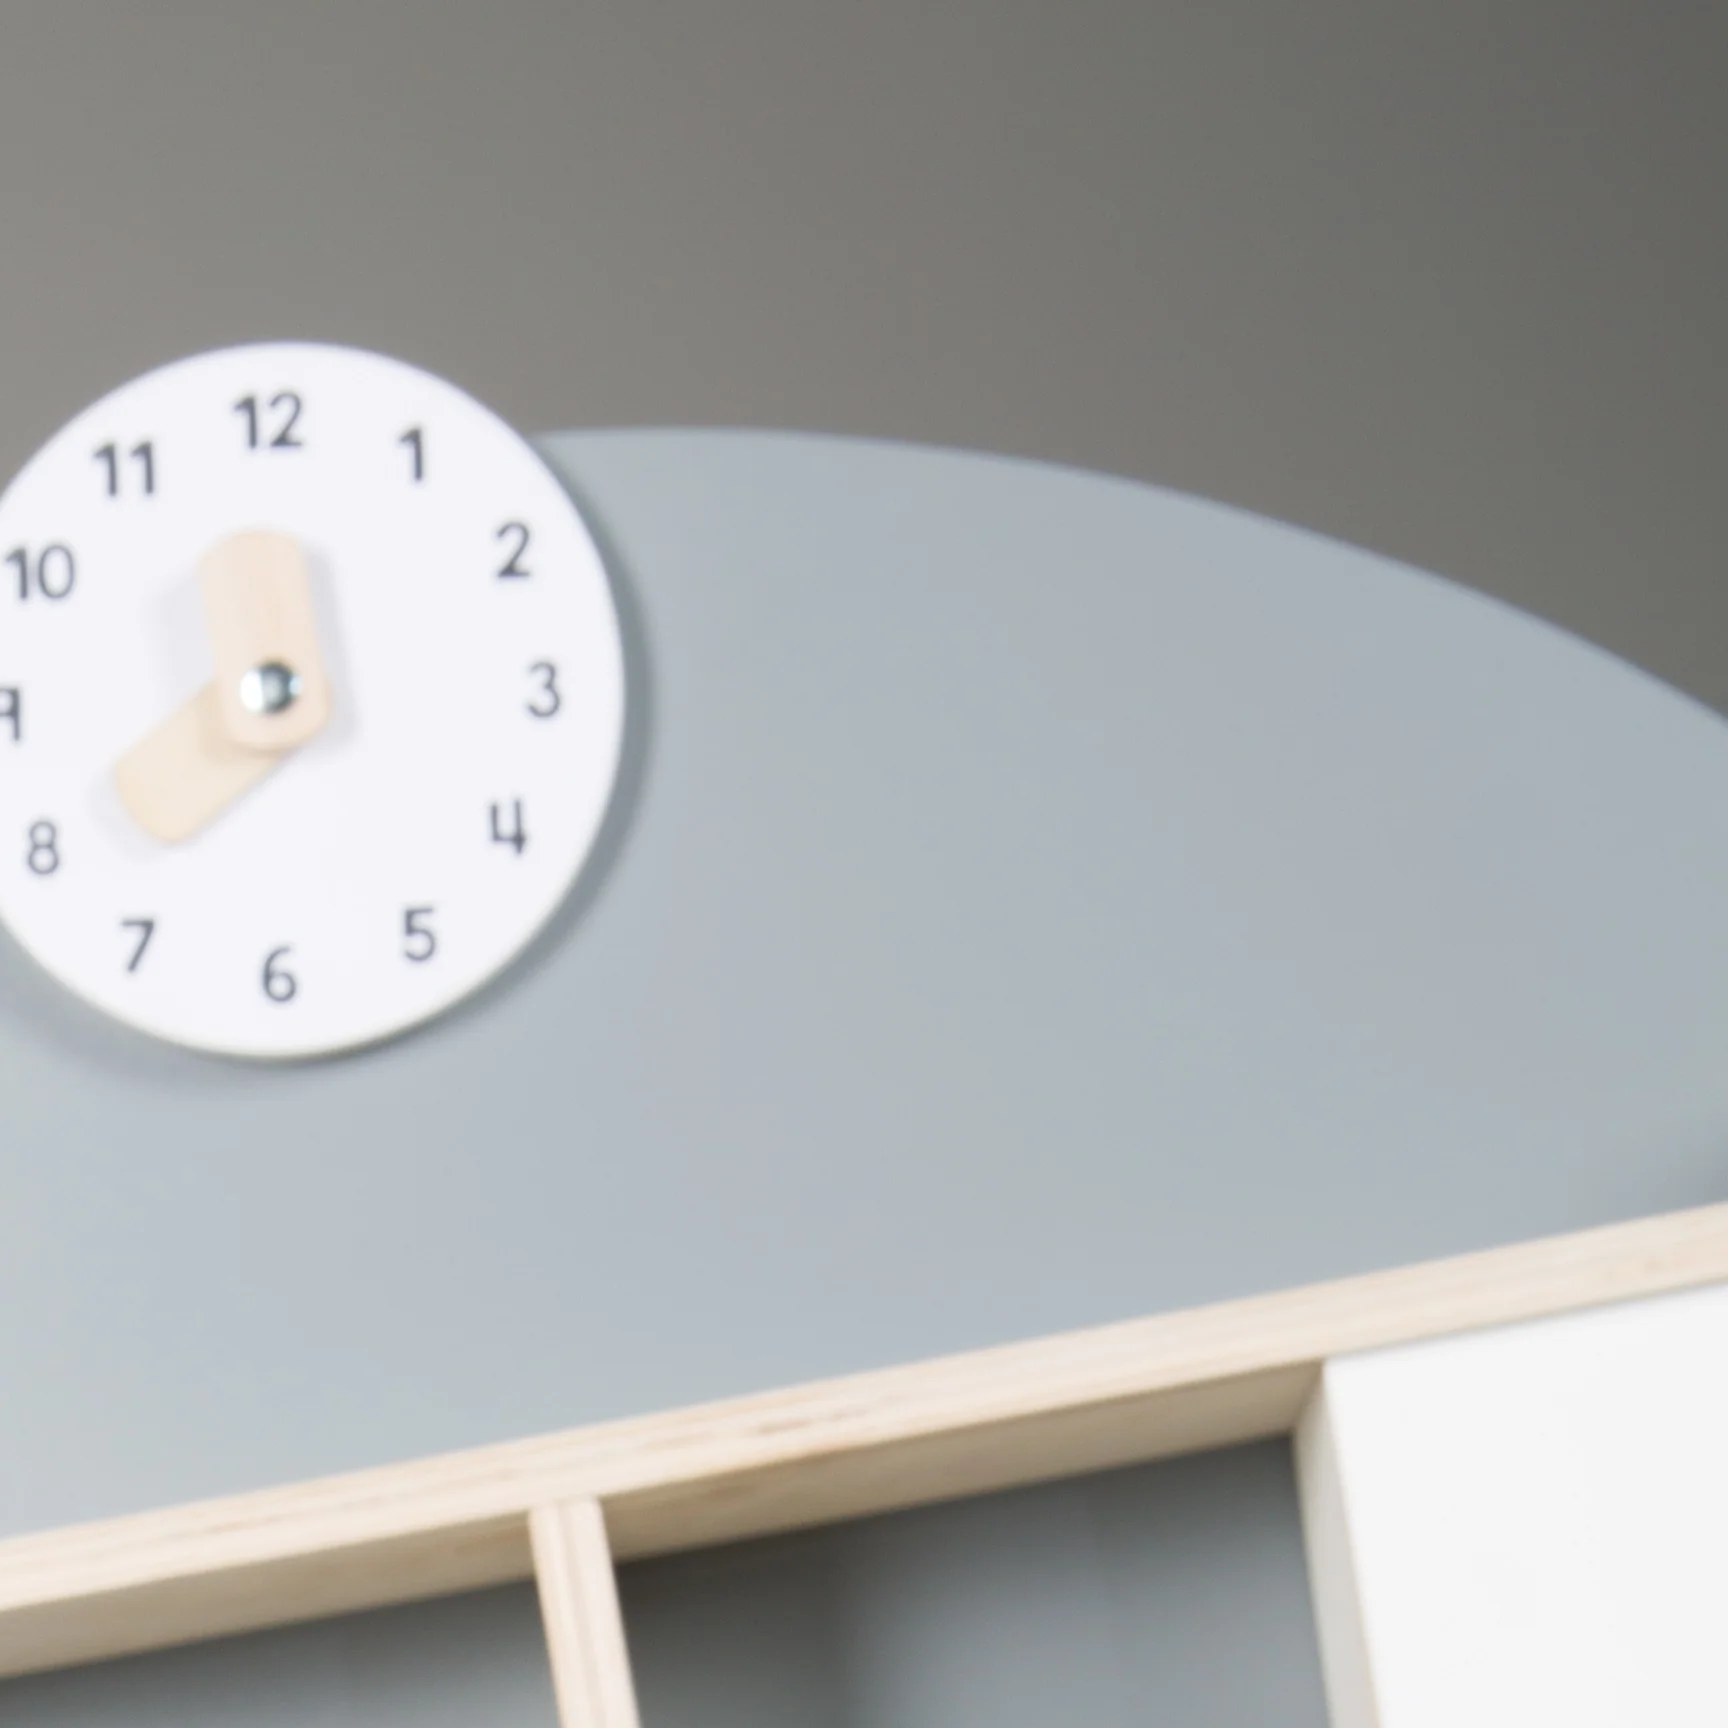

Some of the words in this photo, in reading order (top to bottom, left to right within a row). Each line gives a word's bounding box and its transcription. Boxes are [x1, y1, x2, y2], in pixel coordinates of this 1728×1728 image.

[234, 392, 302, 450] 12
[94, 441, 155, 497] 11
[400, 427, 424, 482] 1
[5, 544, 75, 601] 10
[497, 522, 530, 579] 2
[528, 662, 561, 718] 3
[27, 821, 59, 875] 8
[490, 800, 527, 854] 4
[122, 919, 155, 972] 7
[404, 908, 436, 962] 5
[262, 947, 297, 1003] 6
